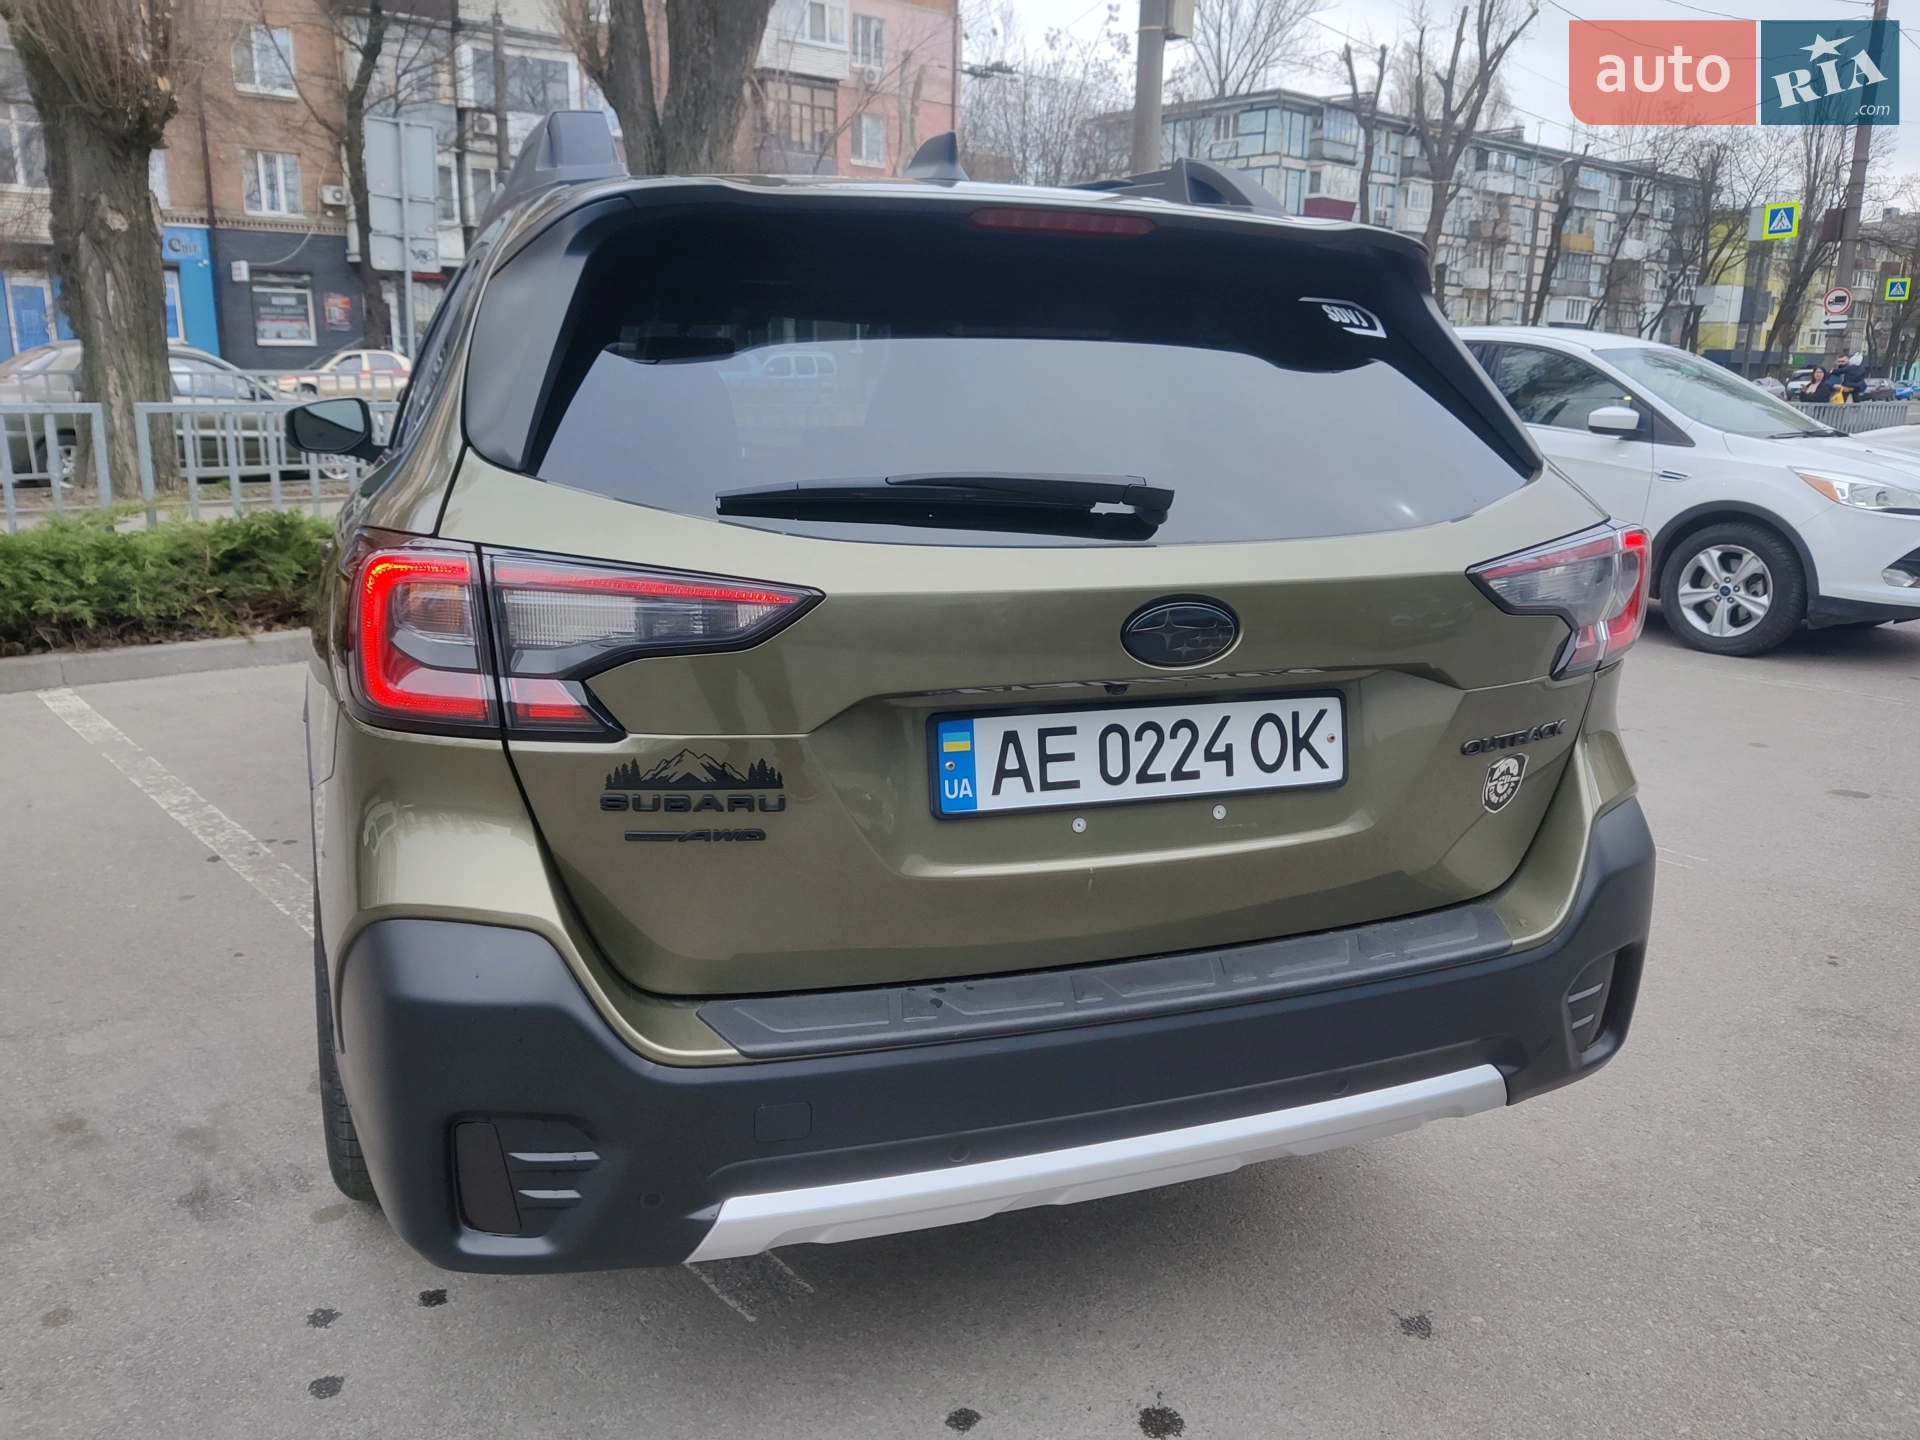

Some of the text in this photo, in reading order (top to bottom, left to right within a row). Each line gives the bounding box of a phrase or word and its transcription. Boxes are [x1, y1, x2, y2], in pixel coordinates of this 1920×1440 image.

[1460, 719, 1567, 756] OUTBACK
[991, 708, 1330, 796] AE 0224 OK
[944, 778, 973, 800] UA
[600, 793, 786, 812] SUBARU
[678, 828, 767, 842] AWD
